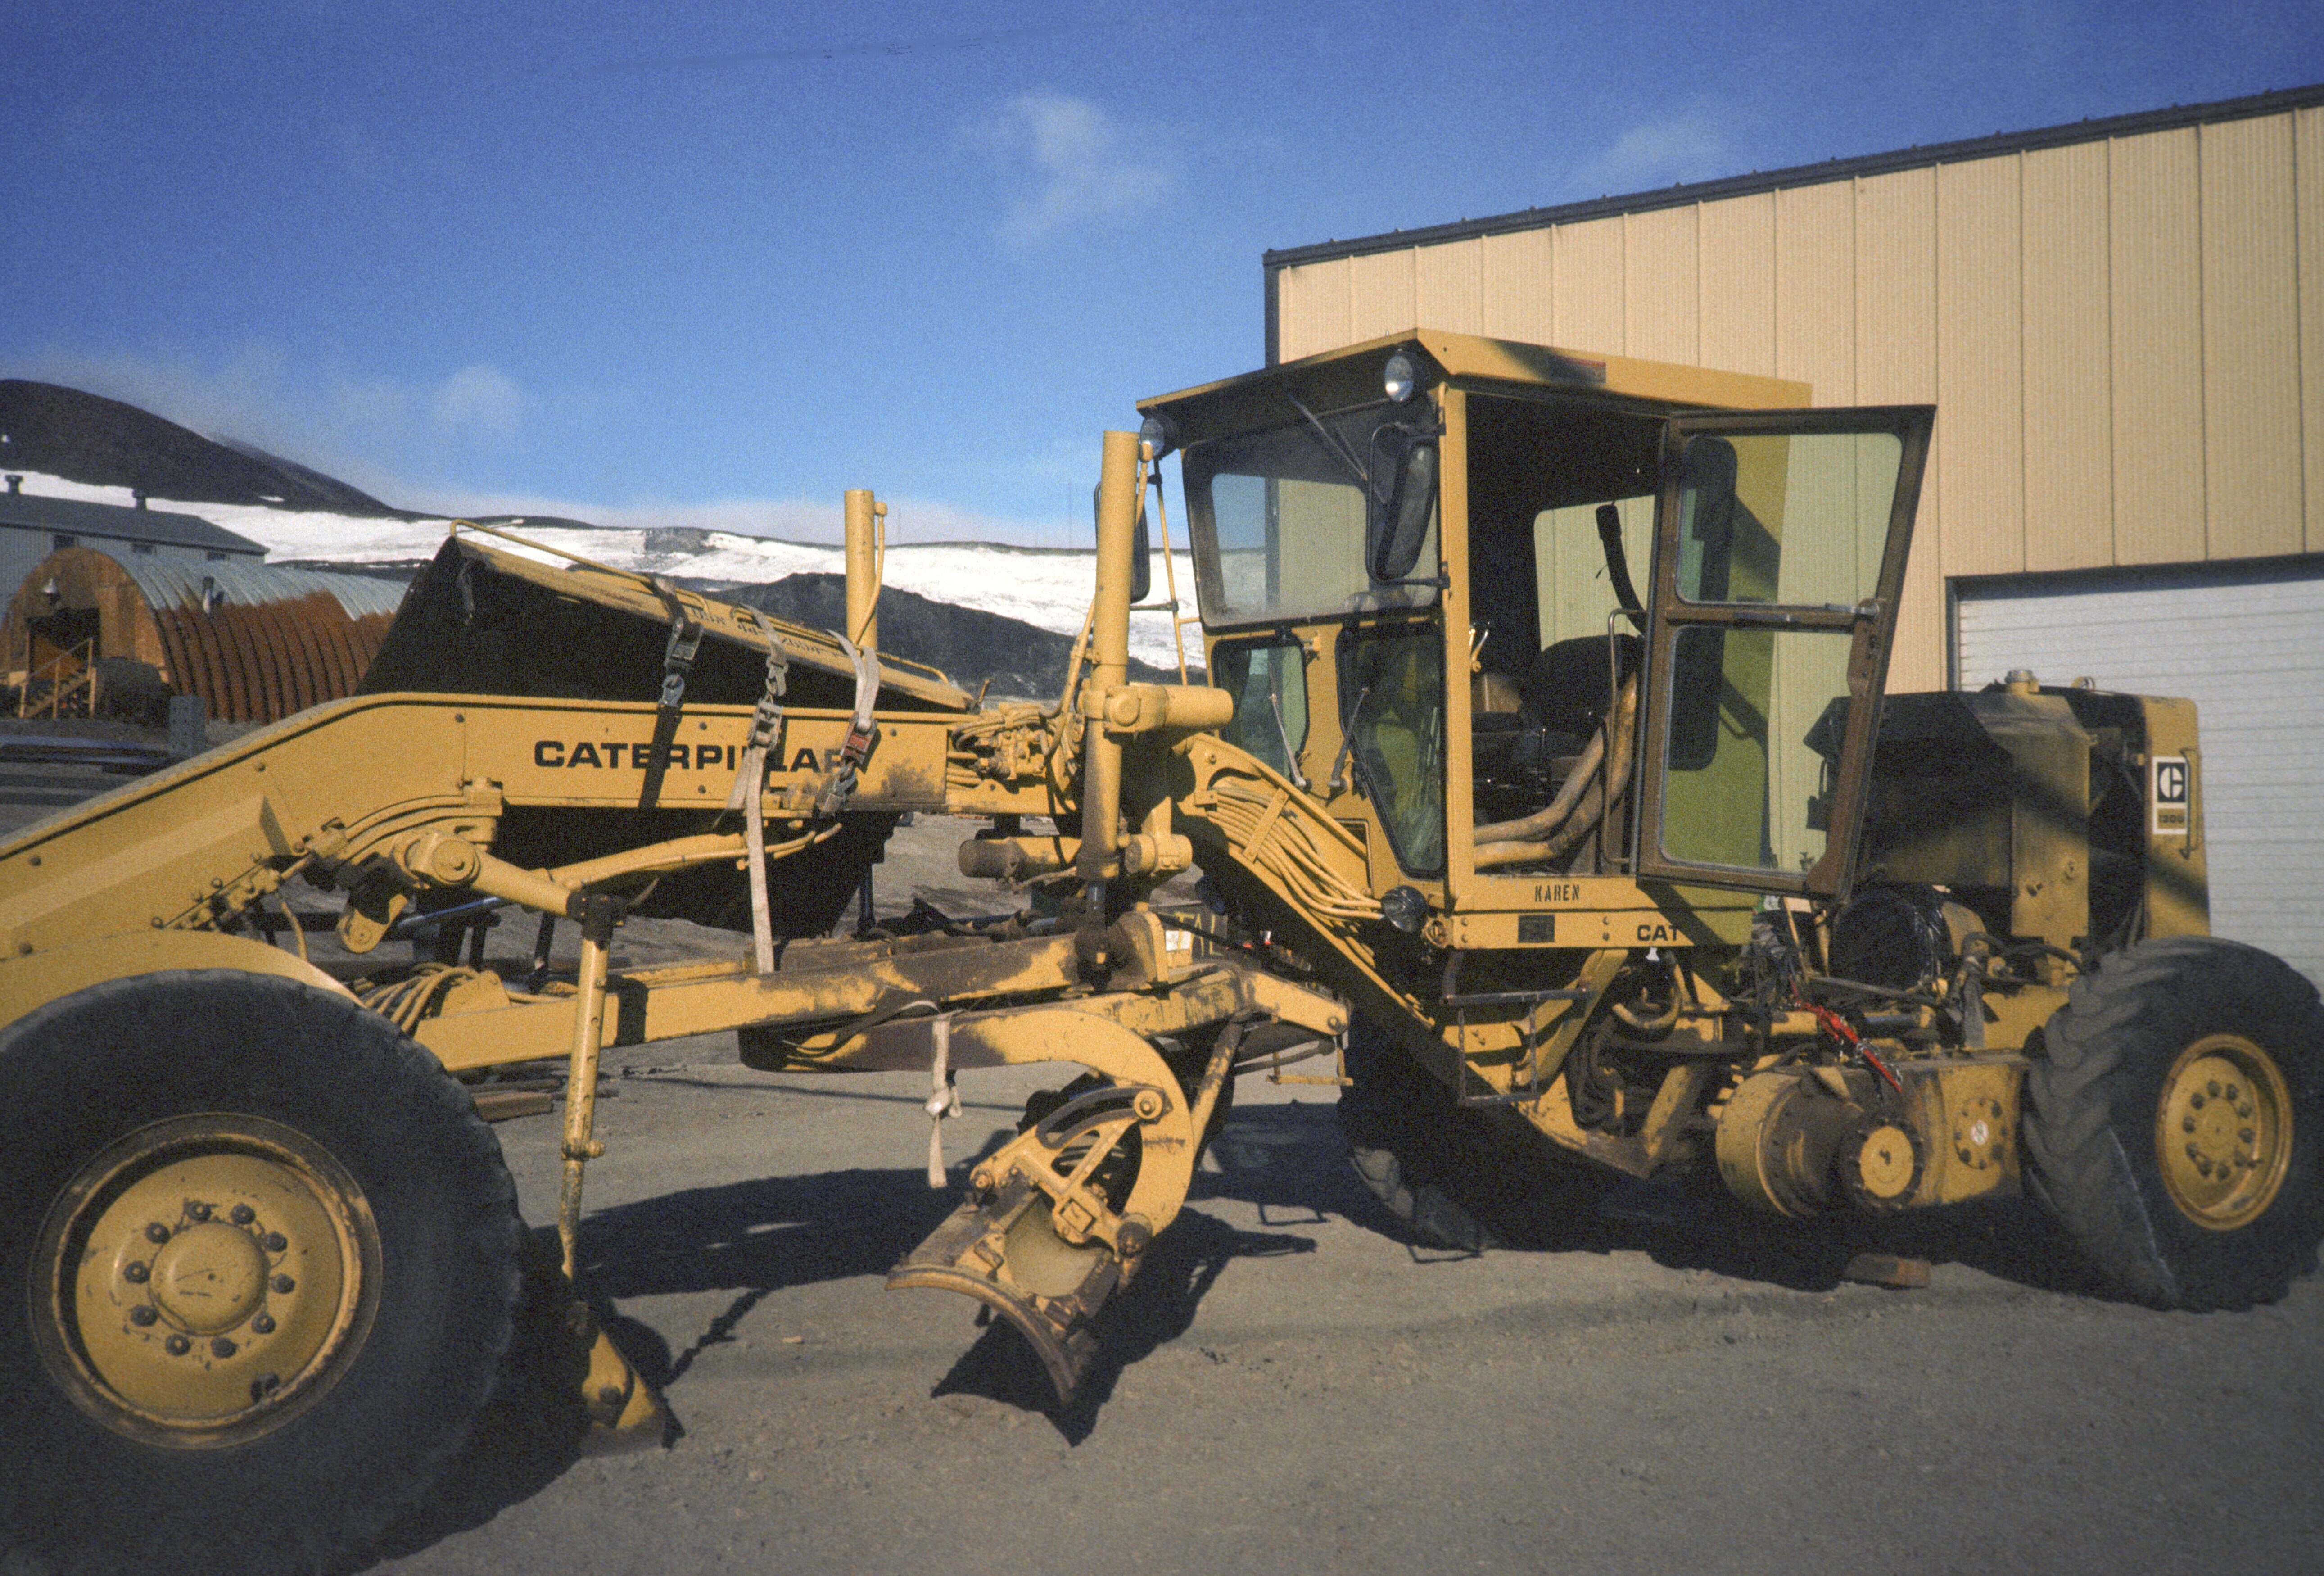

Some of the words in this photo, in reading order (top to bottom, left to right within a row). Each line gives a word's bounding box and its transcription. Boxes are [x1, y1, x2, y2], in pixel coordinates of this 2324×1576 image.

[534, 740, 842, 774] CATERPILAR
[1535, 884, 1579, 902] KAREN
[1637, 925, 1680, 941] CAT
